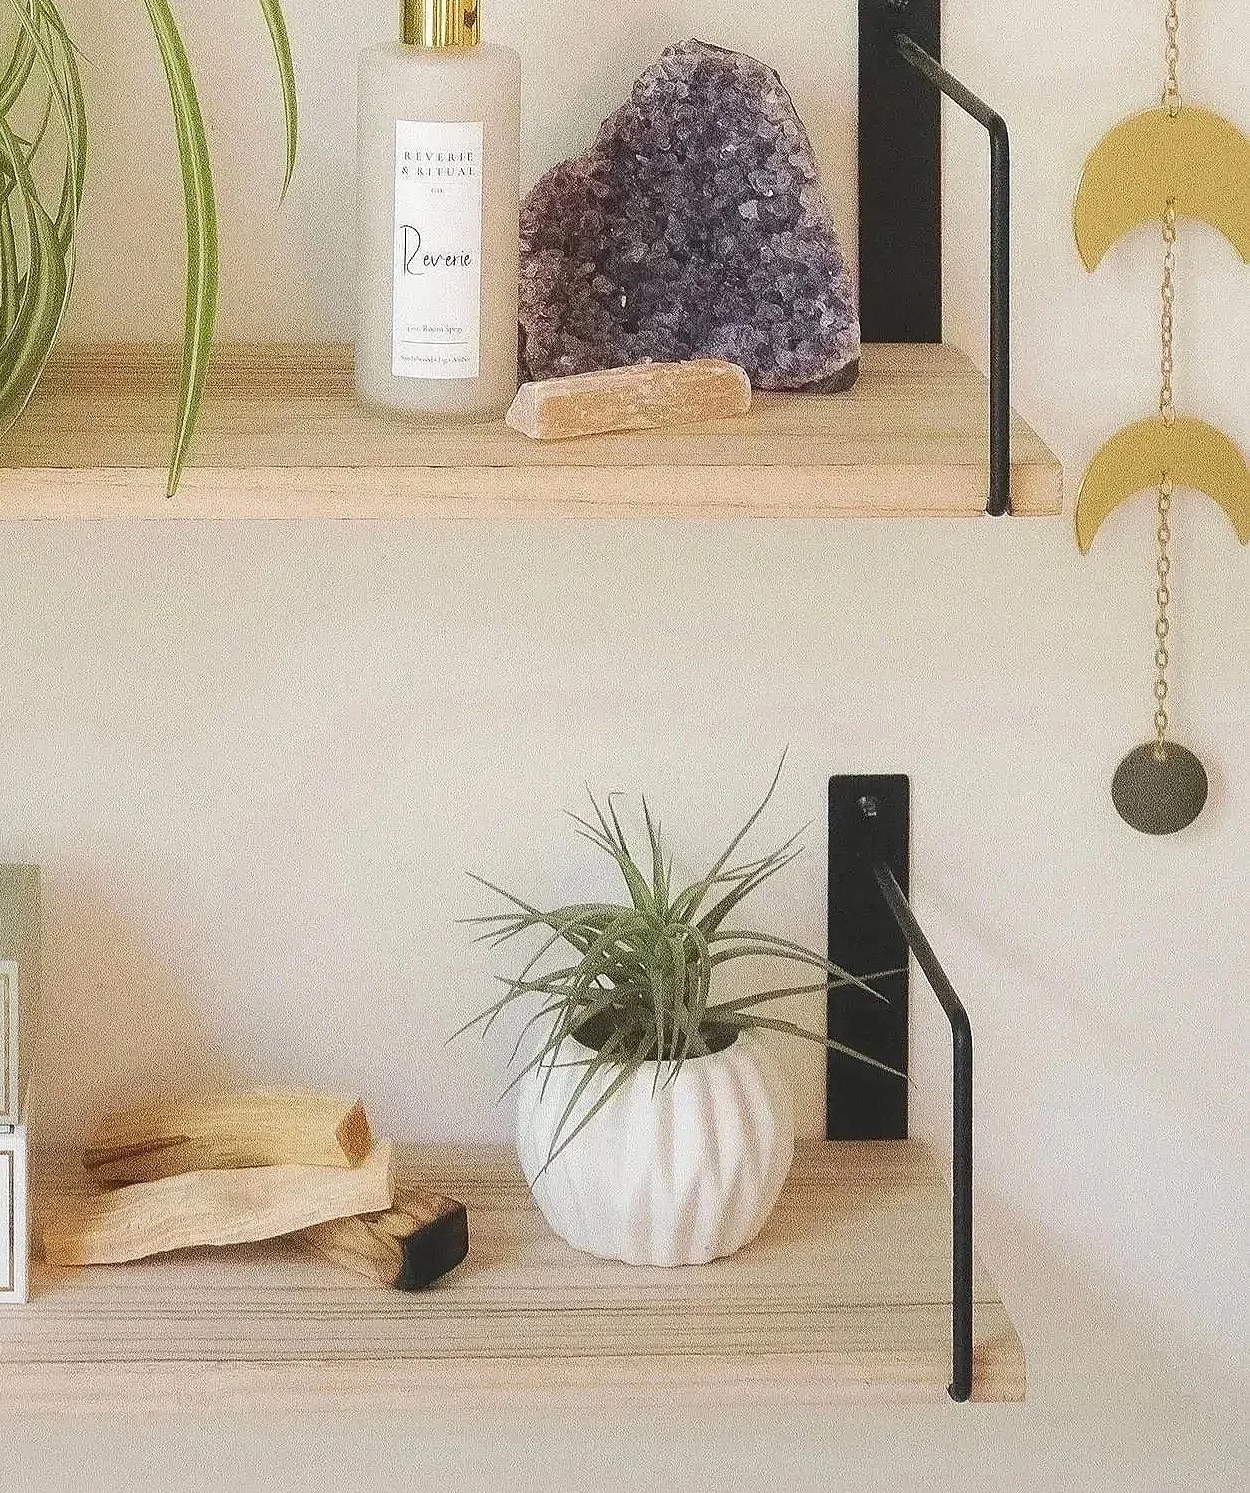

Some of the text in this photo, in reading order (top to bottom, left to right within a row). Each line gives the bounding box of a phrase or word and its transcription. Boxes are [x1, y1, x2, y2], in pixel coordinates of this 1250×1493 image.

[403, 151, 474, 162] REVERIE
[417, 166, 476, 177] RITUAL
[400, 223, 472, 277] Reverie
